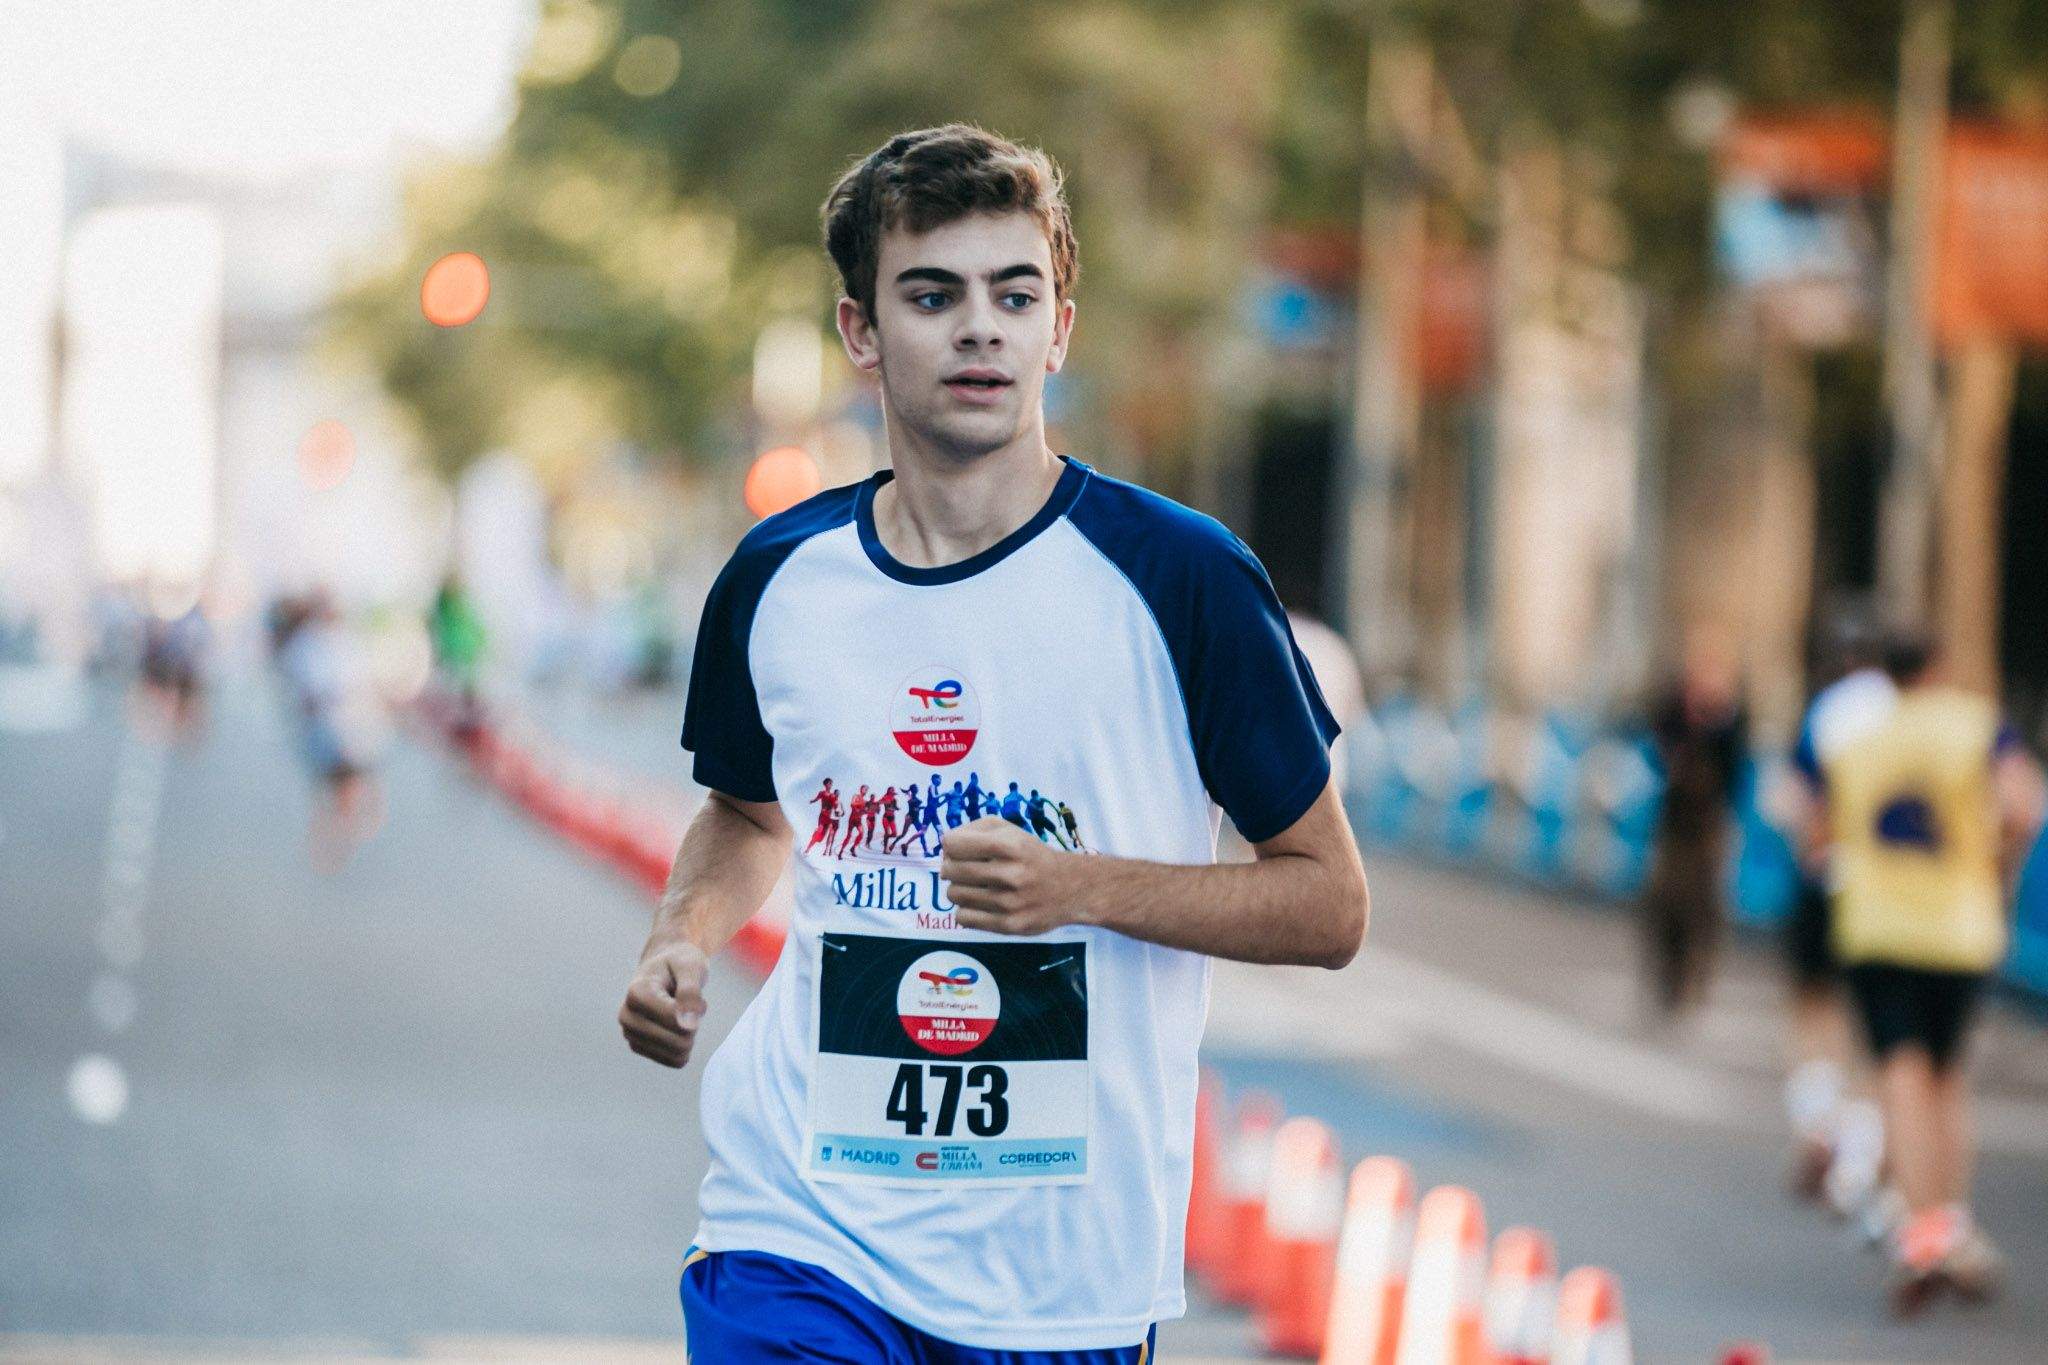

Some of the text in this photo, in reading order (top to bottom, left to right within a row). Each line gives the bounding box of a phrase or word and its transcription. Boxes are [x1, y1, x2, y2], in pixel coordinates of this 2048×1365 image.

[923, 733, 956, 742] MILLA
[911, 743, 967, 754] DE MADRID
[832, 868, 920, 911] Milla
[932, 1020, 966, 1030] MILLA
[917, 1030, 980, 1041] DE MADRID
[886, 1063, 1009, 1137] 473
[841, 1149, 900, 1166] MADRID
[941, 1152, 977, 1160] MILLA
